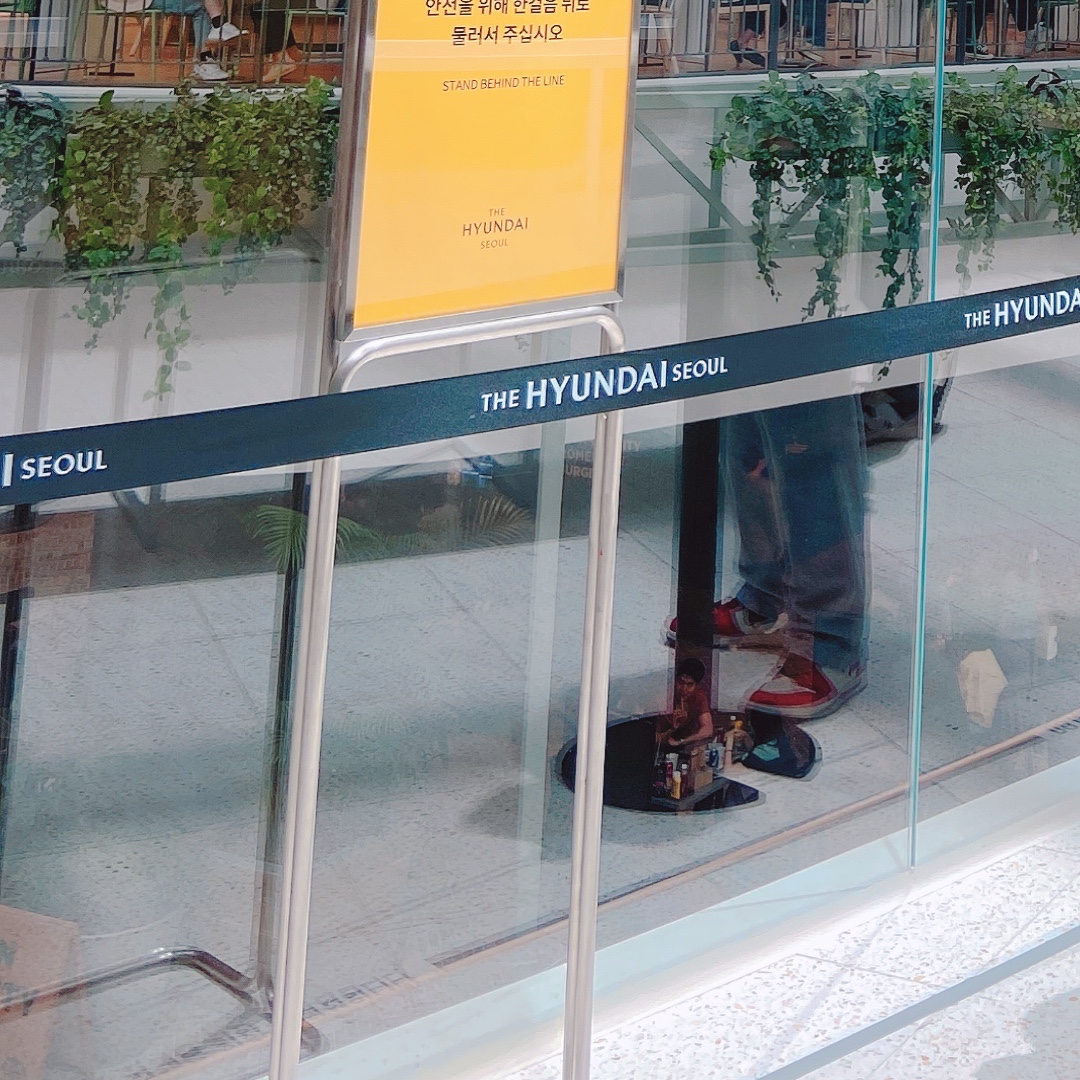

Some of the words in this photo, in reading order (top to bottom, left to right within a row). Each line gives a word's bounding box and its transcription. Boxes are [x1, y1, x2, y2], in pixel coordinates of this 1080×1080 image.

[451, 25, 499, 46] 물러서
[503, 23, 563, 45] 주십시오
[442, 79, 478, 91] STAND
[480, 77, 519, 90] BEHIND
[521, 76, 541, 87] THE
[543, 74, 565, 86] LINE
[489, 208, 505, 217] THE
[462, 217, 528, 236] HYUNDAI
[480, 239, 508, 249] SEOUL
[964, 309, 991, 329] THE
[481, 388, 519, 412] THE
[526, 360, 668, 410] HYUNDAI
[672, 356, 728, 382] SEOUL
[21, 449, 108, 480] SEOUL
